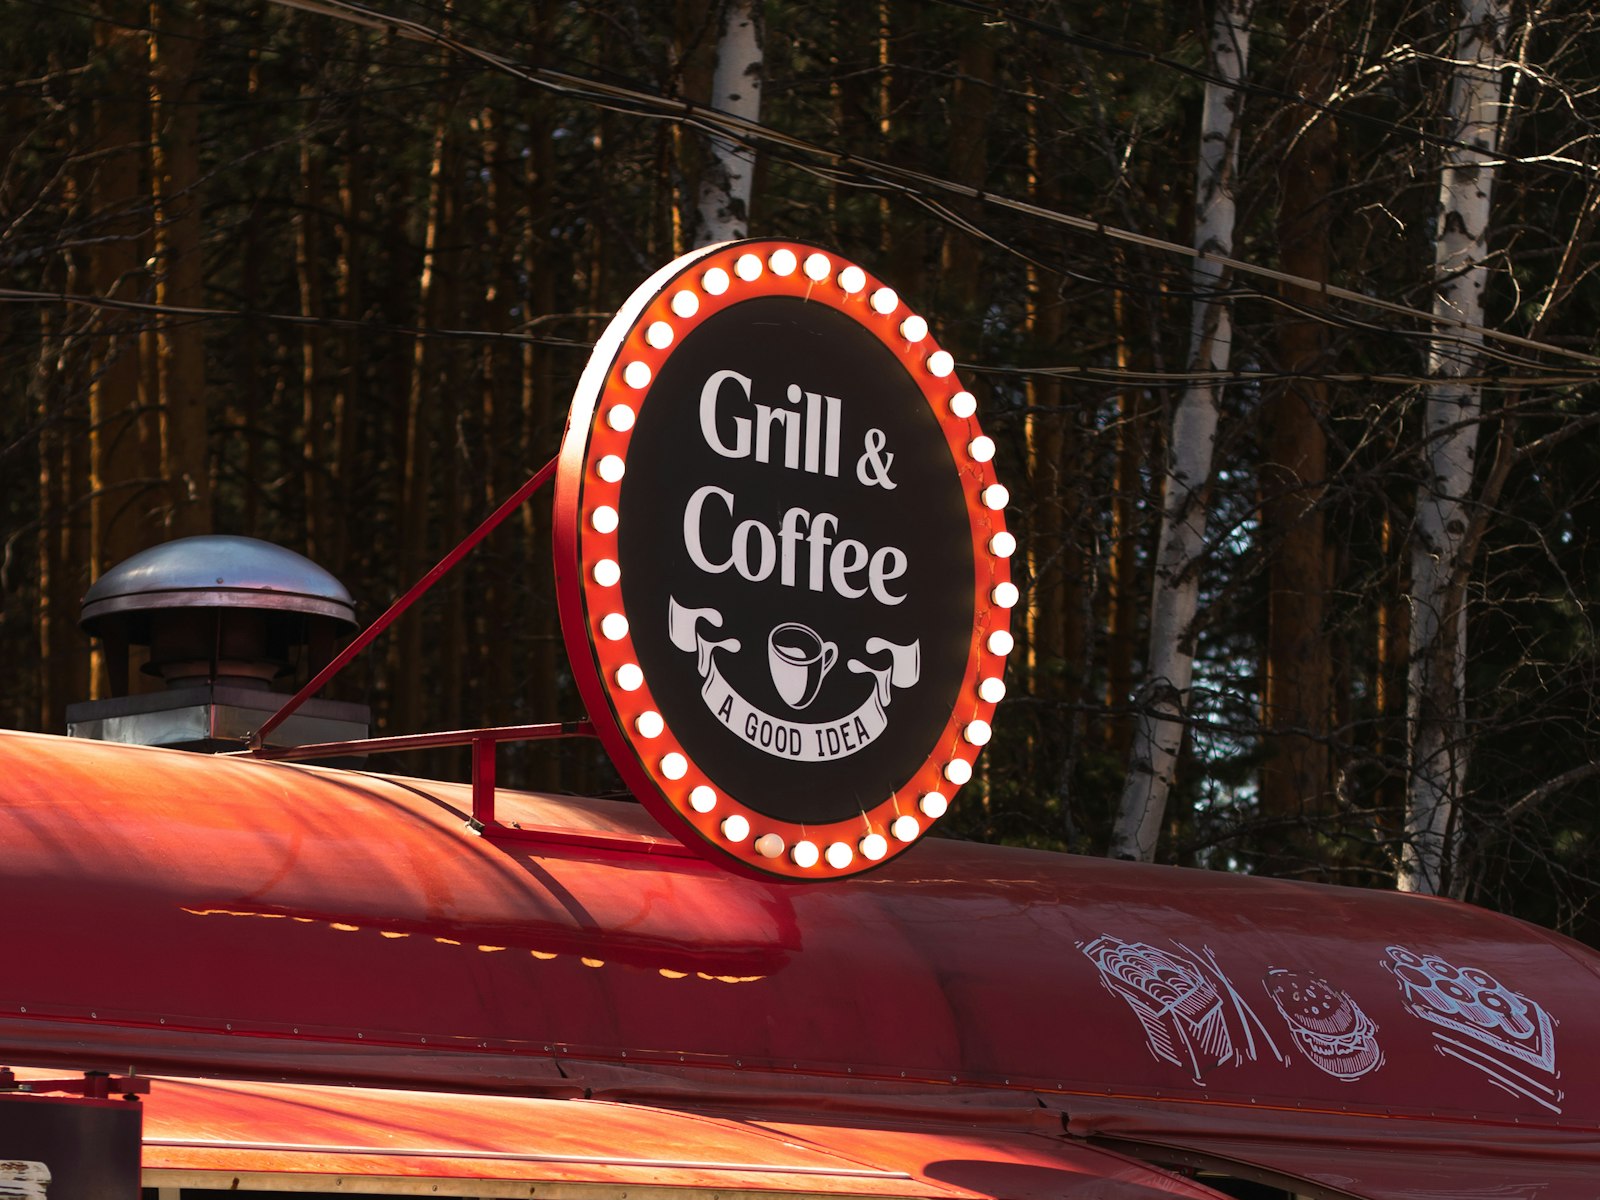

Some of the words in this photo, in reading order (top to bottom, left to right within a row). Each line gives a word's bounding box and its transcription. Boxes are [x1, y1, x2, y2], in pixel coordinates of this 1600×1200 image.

[699, 369, 842, 478] Grill
[856, 428, 897, 490] &
[683, 485, 908, 606] Coffee
[718, 694, 734, 723] A
[745, 712, 802, 756] GOOD
[815, 716, 870, 757] IDEA
